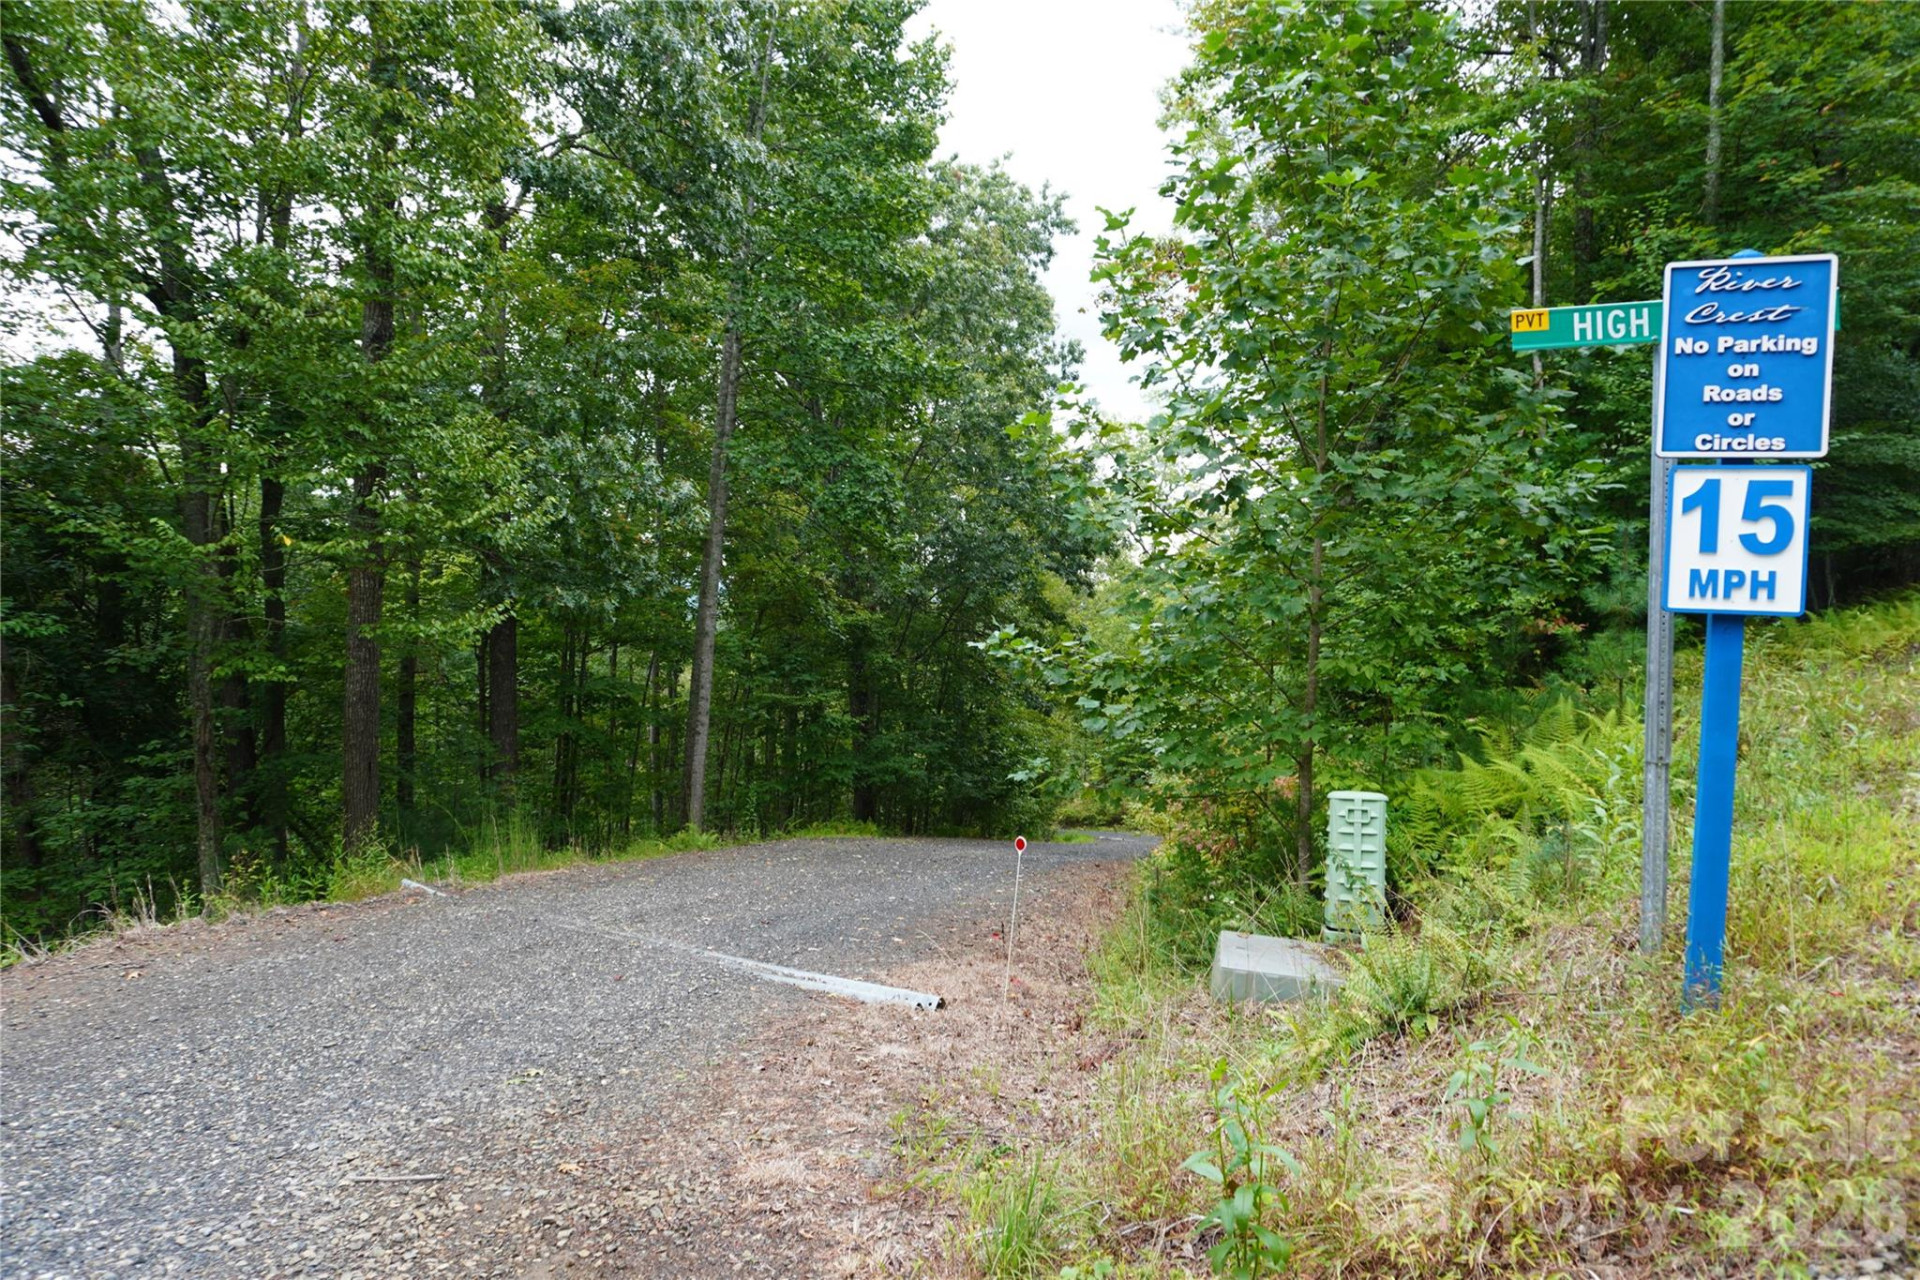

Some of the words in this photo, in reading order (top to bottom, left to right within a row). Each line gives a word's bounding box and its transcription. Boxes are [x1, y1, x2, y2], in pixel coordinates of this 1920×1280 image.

[1694, 265, 1802, 294] River
[1515, 312, 1545, 328] PVT
[1572, 307, 1650, 342] HIGH
[1685, 302, 1803, 325] Crest
[1674, 337, 1710, 355] No
[1717, 333, 1818, 356] Parking
[1727, 364, 1760, 378] on
[1703, 385, 1783, 402] Roads
[1727, 412, 1756, 428] or
[1694, 434, 1786, 452] Circles
[1682, 478, 1796, 556] 15
[1689, 569, 1777, 601] MPH
